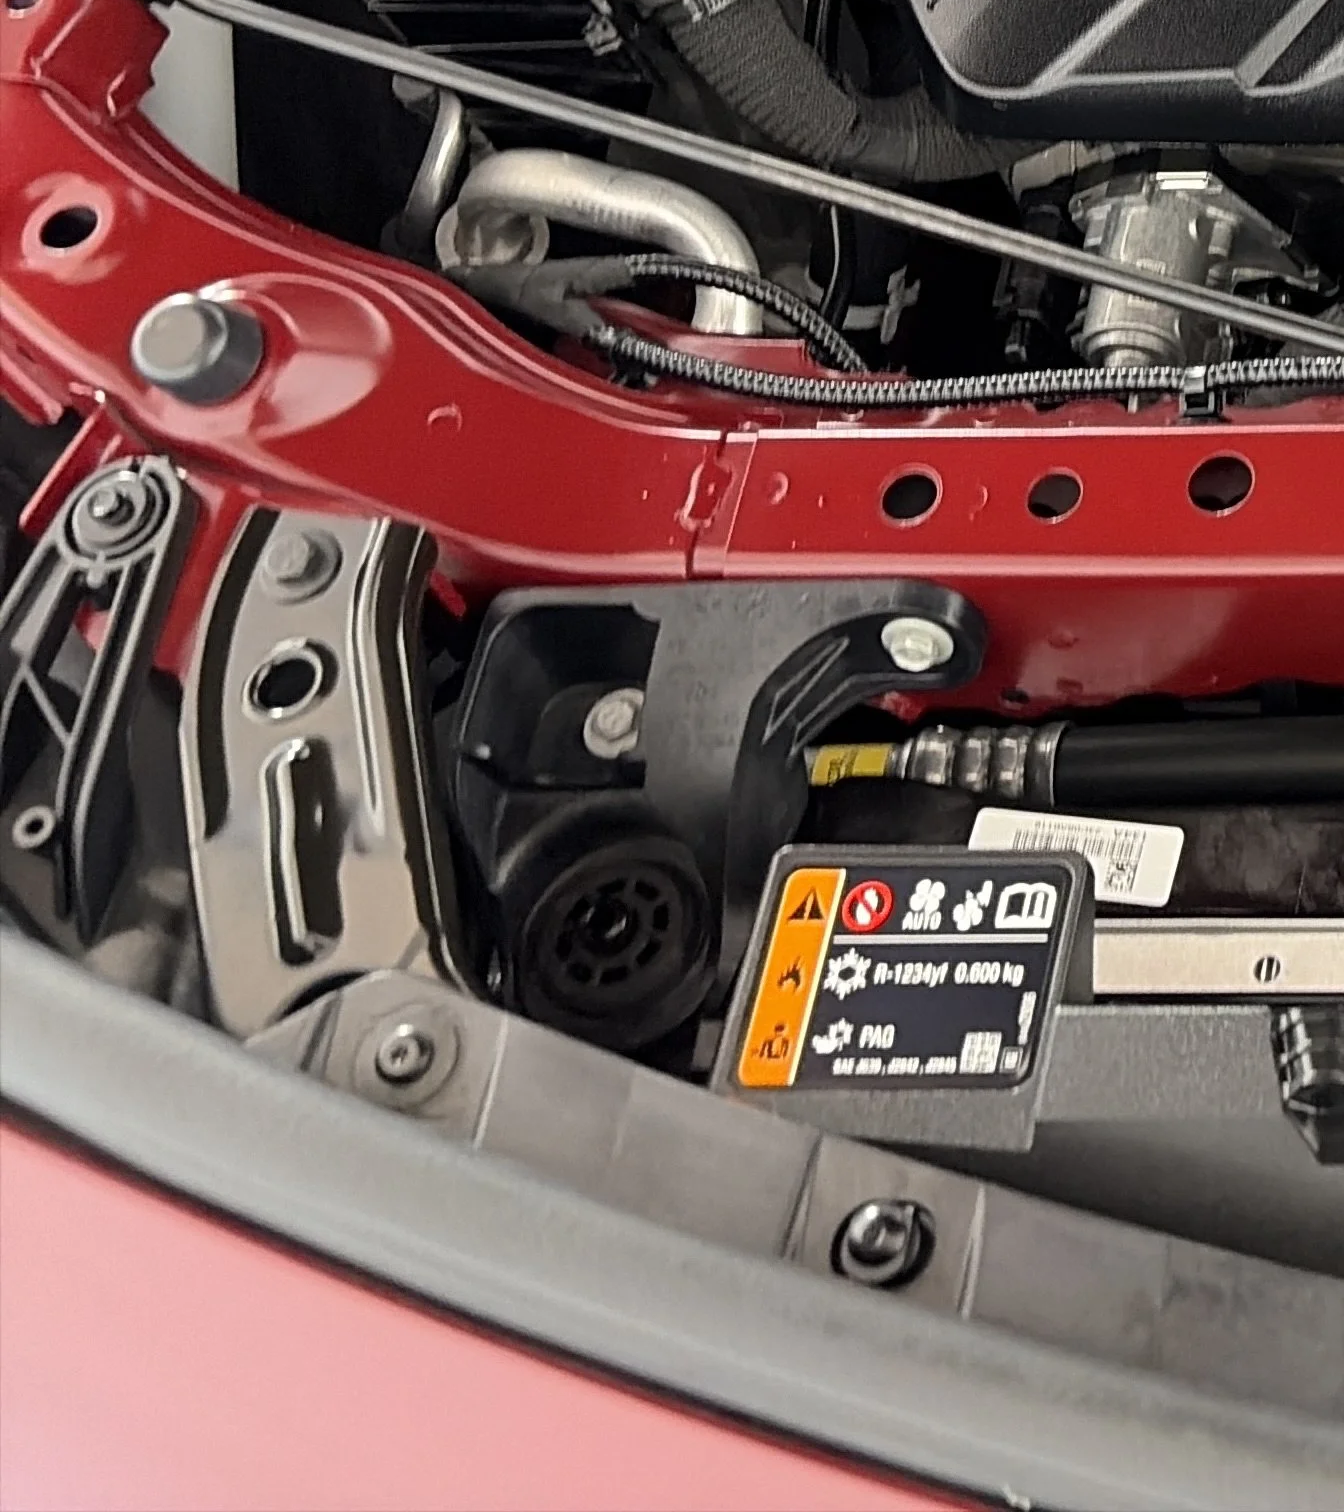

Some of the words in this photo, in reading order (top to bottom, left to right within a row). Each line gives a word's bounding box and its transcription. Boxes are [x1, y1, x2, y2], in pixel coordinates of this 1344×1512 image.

[901, 910, 942, 930] AUTO
[873, 961, 949, 988] R-1234yf
[953, 961, 1001, 985] 0.600
[1002, 961, 1025, 988] kg
[858, 1023, 896, 1049] PAG
